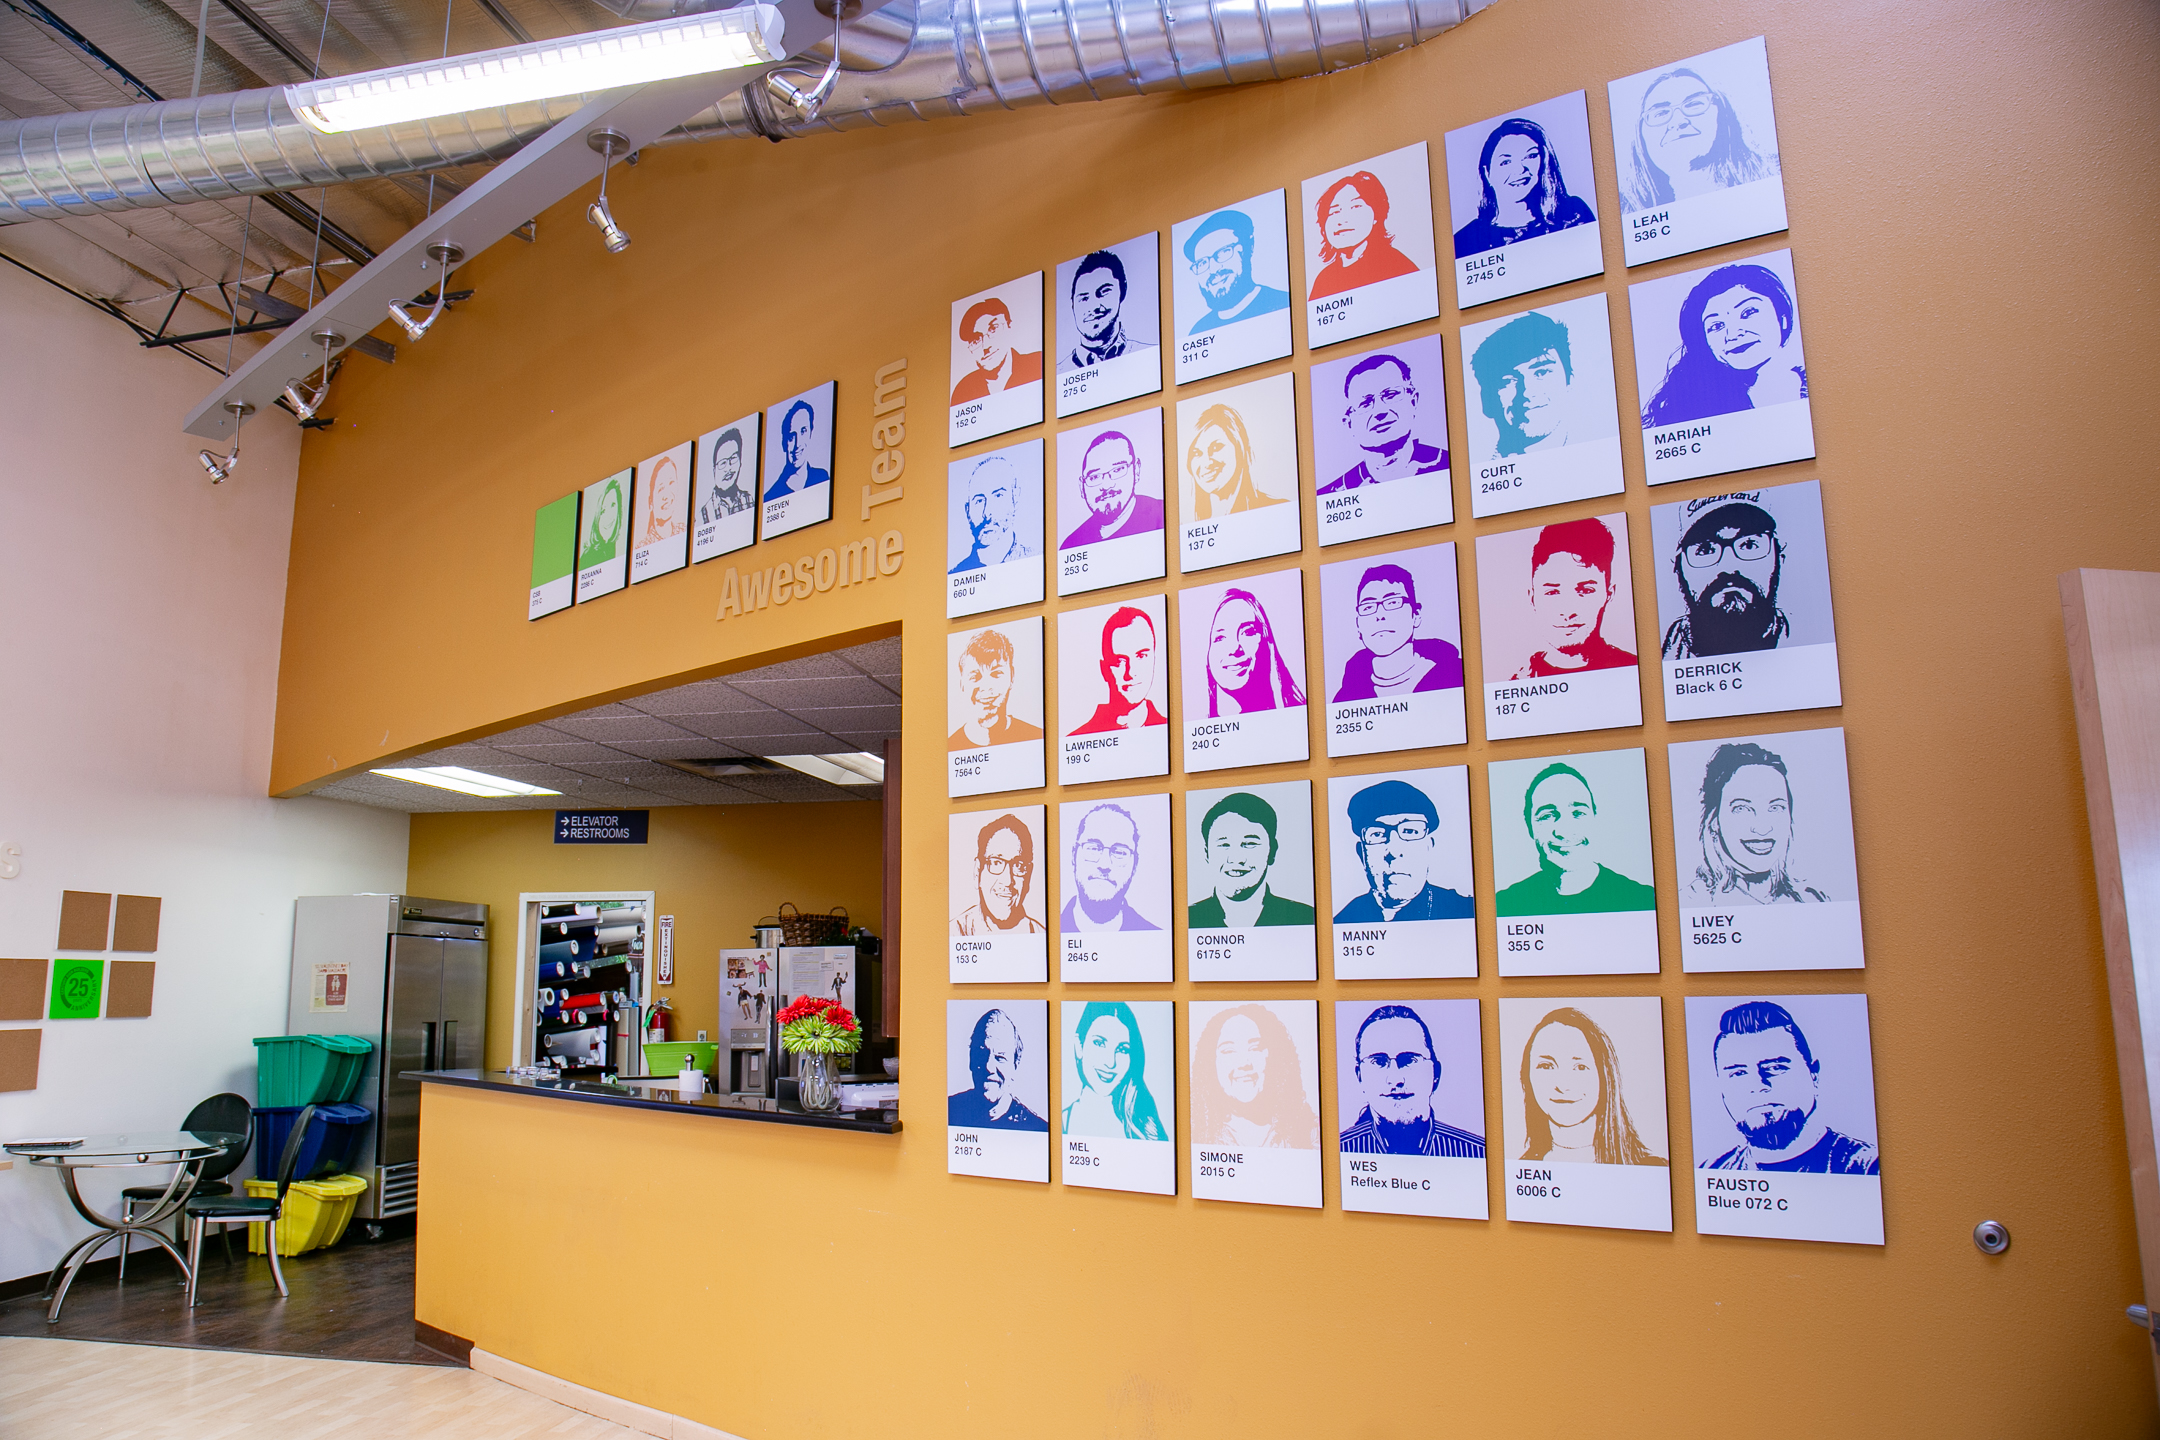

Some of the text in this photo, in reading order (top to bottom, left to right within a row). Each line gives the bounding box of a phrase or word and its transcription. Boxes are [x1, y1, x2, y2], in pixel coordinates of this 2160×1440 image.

[1633, 211, 1669, 228] LEAH
[1635, 225, 1670, 242] 536 C
[1466, 253, 1504, 272] ELLEN
[1467, 267, 1506, 285] 2745 C
[1316, 296, 1353, 314] NAOMI
[1317, 311, 1345, 326] 167 C
[1182, 334, 1216, 352] CASEY
[1182, 349, 1209, 364] 311 C
[1063, 369, 1098, 386] JOSEPH
[1064, 384, 1086, 398] 275 C
[955, 403, 982, 418] JASON
[956, 416, 976, 428] 152 C
[861, 357, 908, 521] Team
[1654, 425, 1711, 445] MARIAH
[1656, 443, 1701, 460] 2665 C
[1481, 463, 1515, 479] CURT
[1482, 477, 1522, 493] 2460 C
[766, 499, 790, 514] STEVEN
[1326, 495, 1360, 510] MARK
[1326, 508, 1363, 523] 2602 C
[697, 524, 716, 537] BOBBY
[1188, 524, 1219, 538] KELLY
[1189, 538, 1215, 551] 137 C
[635, 549, 649, 560] ELIZA
[1064, 551, 1088, 564] JOSE
[716, 529, 904, 621] Awesome
[1065, 563, 1088, 576] 253 C
[954, 573, 986, 587] DAMIEN
[953, 587, 975, 598] 660 U
[1675, 661, 1742, 679] DERRICK
[1494, 682, 1569, 700] FERNANDO
[1676, 678, 1742, 695] Black 6 C
[1335, 702, 1408, 720] JOHNATHAN
[1496, 702, 1530, 715] 187 C
[1192, 722, 1239, 737] JOCELYN
[1336, 720, 1373, 734] 2355 C
[1066, 737, 1119, 752] LAWRENCE
[1192, 738, 1220, 750] 240 C
[954, 753, 989, 766] CHANCE
[1066, 753, 1090, 764] 199 C
[955, 766, 981, 777] 7564 C
[571, 816, 619, 826] ELEVATOR
[570, 828, 630, 838] RESTROOMS
[1692, 915, 1734, 928] LIVEY
[1343, 930, 1387, 941] MANNY
[1508, 924, 1544, 935] LEON
[1068, 939, 1082, 948] ELI
[1197, 935, 1245, 945] CONNOR
[1693, 932, 1742, 945] 5625 C
[955, 941, 992, 951] OCTAVIO
[1343, 945, 1374, 956] 315 C
[1508, 940, 1544, 951] 355 C
[956, 954, 977, 964] 153 C
[1068, 952, 1098, 962] 2645 C
[1197, 949, 1231, 959] 6175 C
[68, 977, 89, 997] 25
[954, 1133, 978, 1143] JOHN
[955, 1146, 982, 1156] 2187 C
[1069, 1141, 1090, 1152] MEL
[1069, 1155, 1100, 1167] 2239 C
[1200, 1151, 1243, 1164] SIMONE
[1200, 1166, 1235, 1178] 2015 C
[1349, 1160, 1377, 1172] WES
[1516, 1169, 1551, 1181] JEAN
[1351, 1176, 1430, 1190] Reflex Blue C
[1707, 1178, 1769, 1192] FAUSTO
[1517, 1185, 1561, 1198] 6006 C
[1708, 1195, 1788, 1211] Blue 072 C
